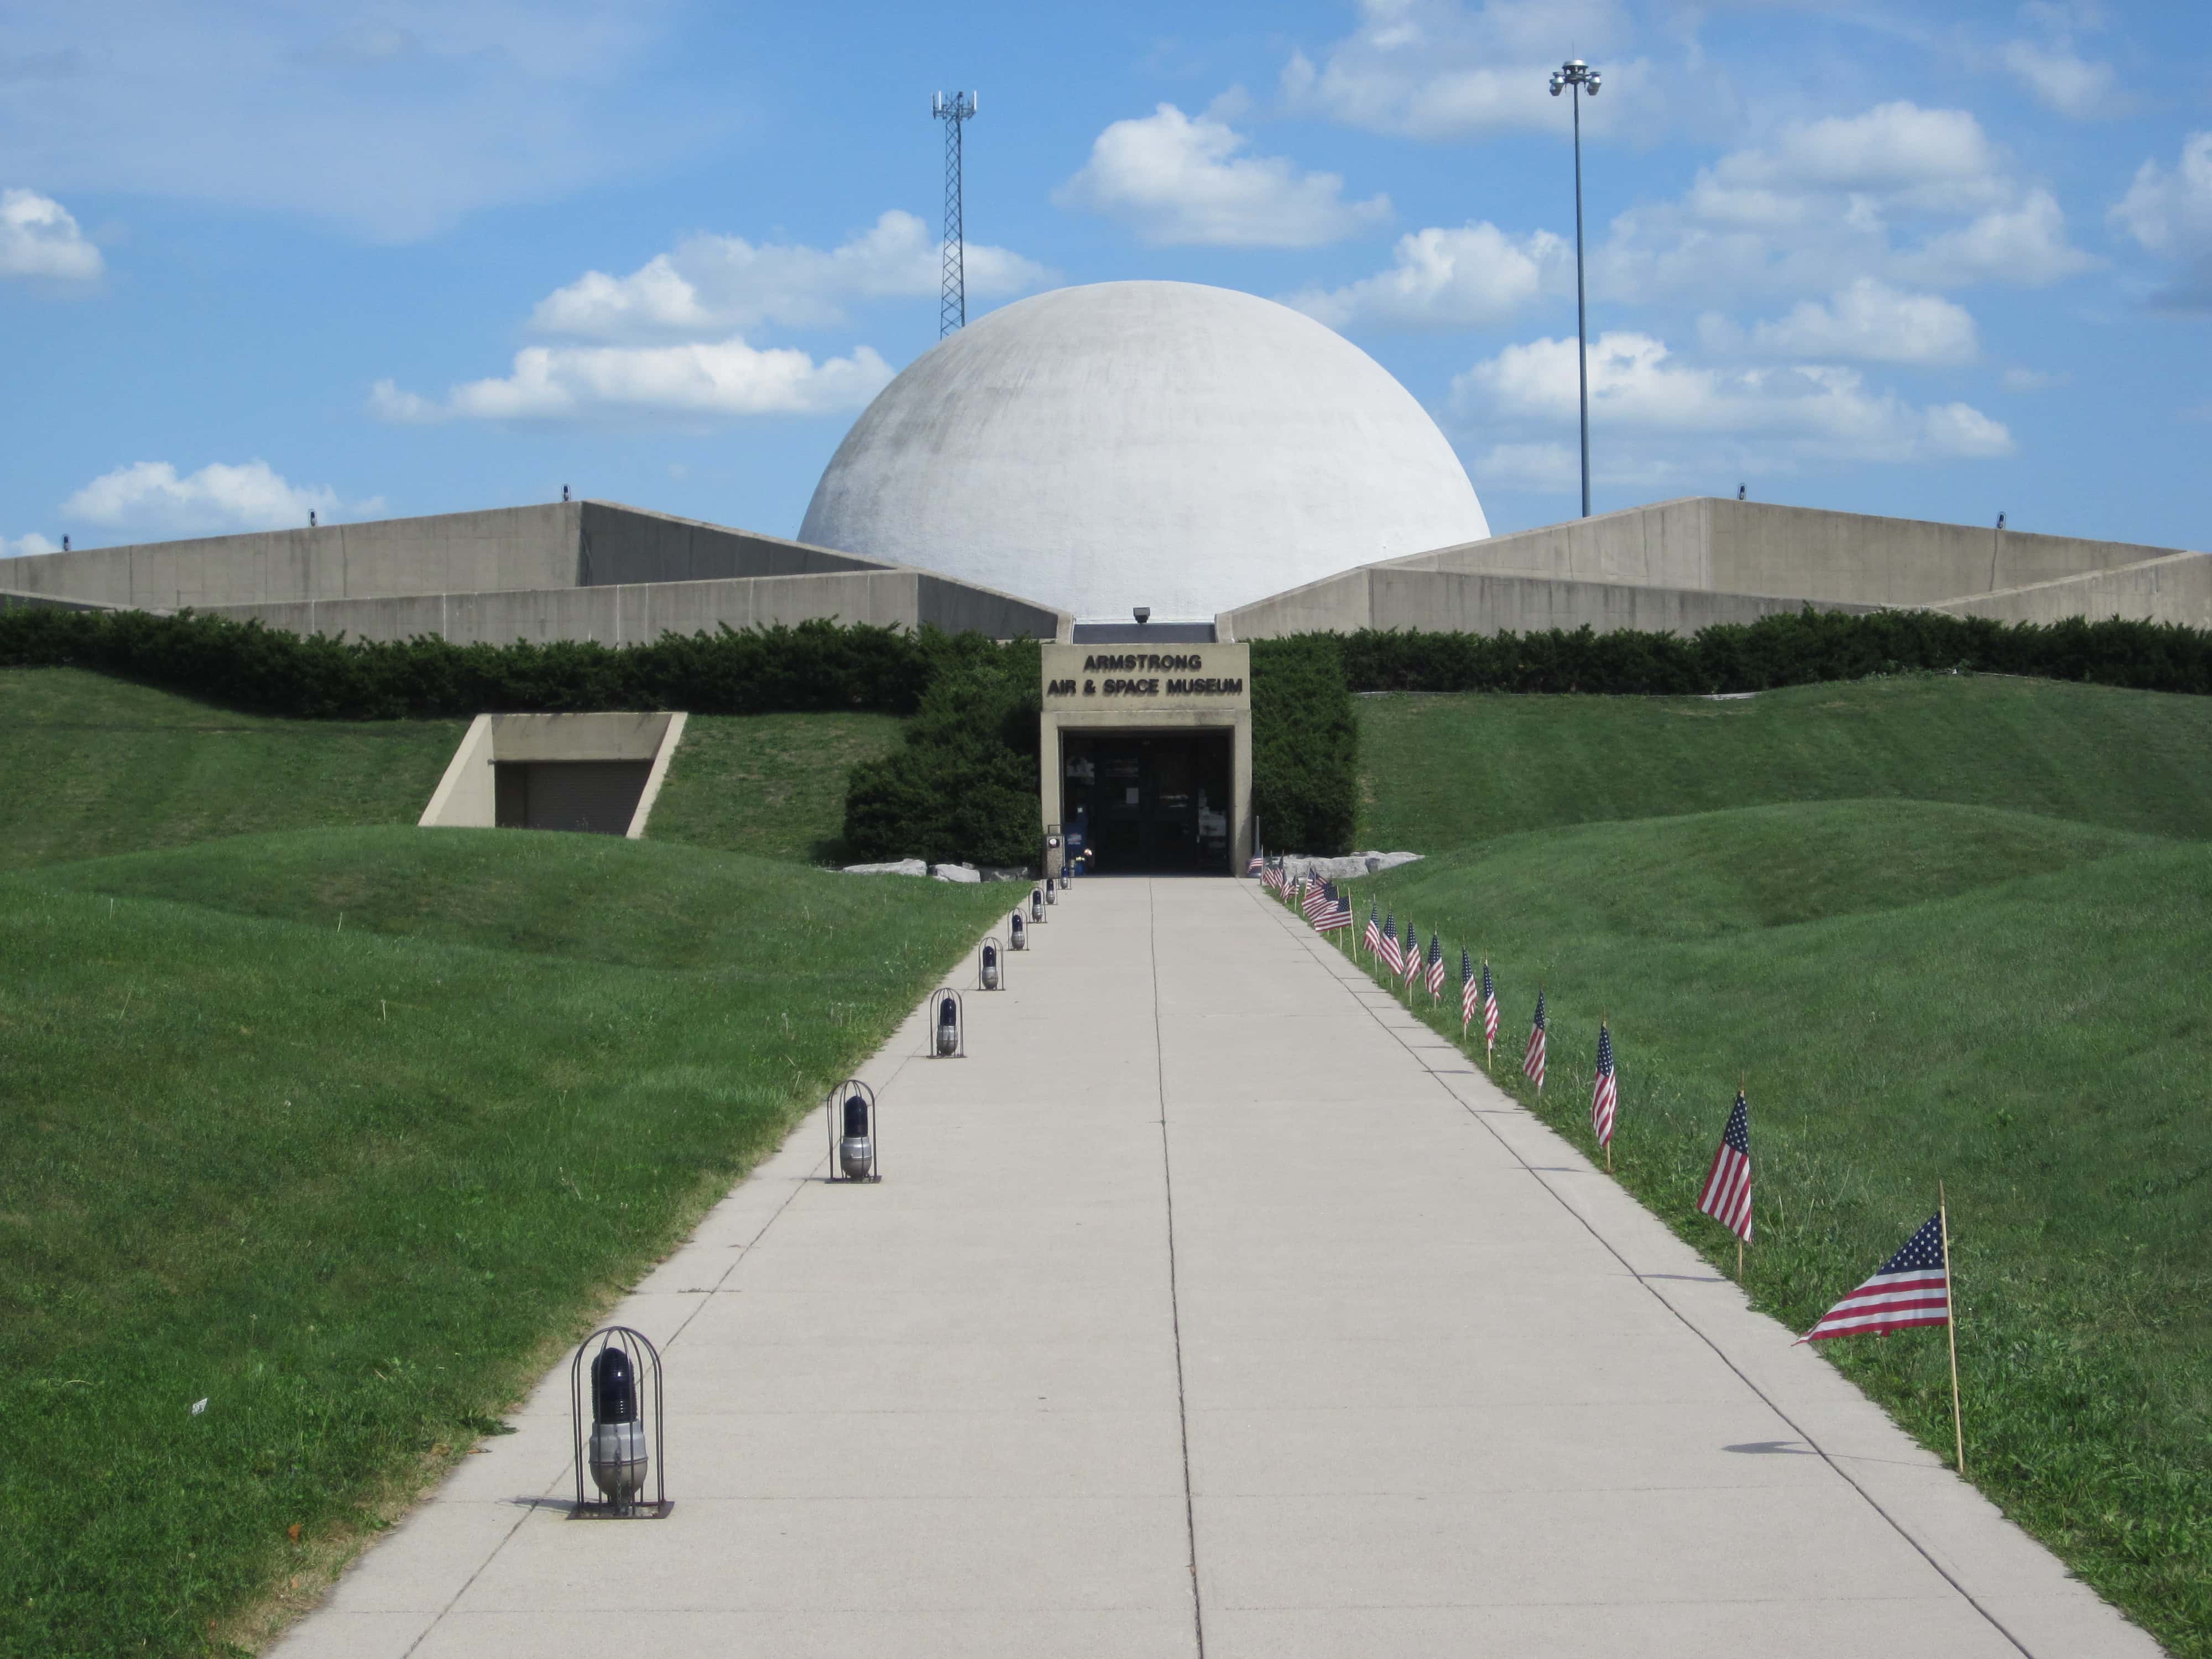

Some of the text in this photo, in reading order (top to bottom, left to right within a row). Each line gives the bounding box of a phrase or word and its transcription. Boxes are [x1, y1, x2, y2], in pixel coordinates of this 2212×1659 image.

[1084, 654, 1202, 670] ARMSTRONG
[1047, 678, 1243, 695] AIR & SPACE MUSEUM
